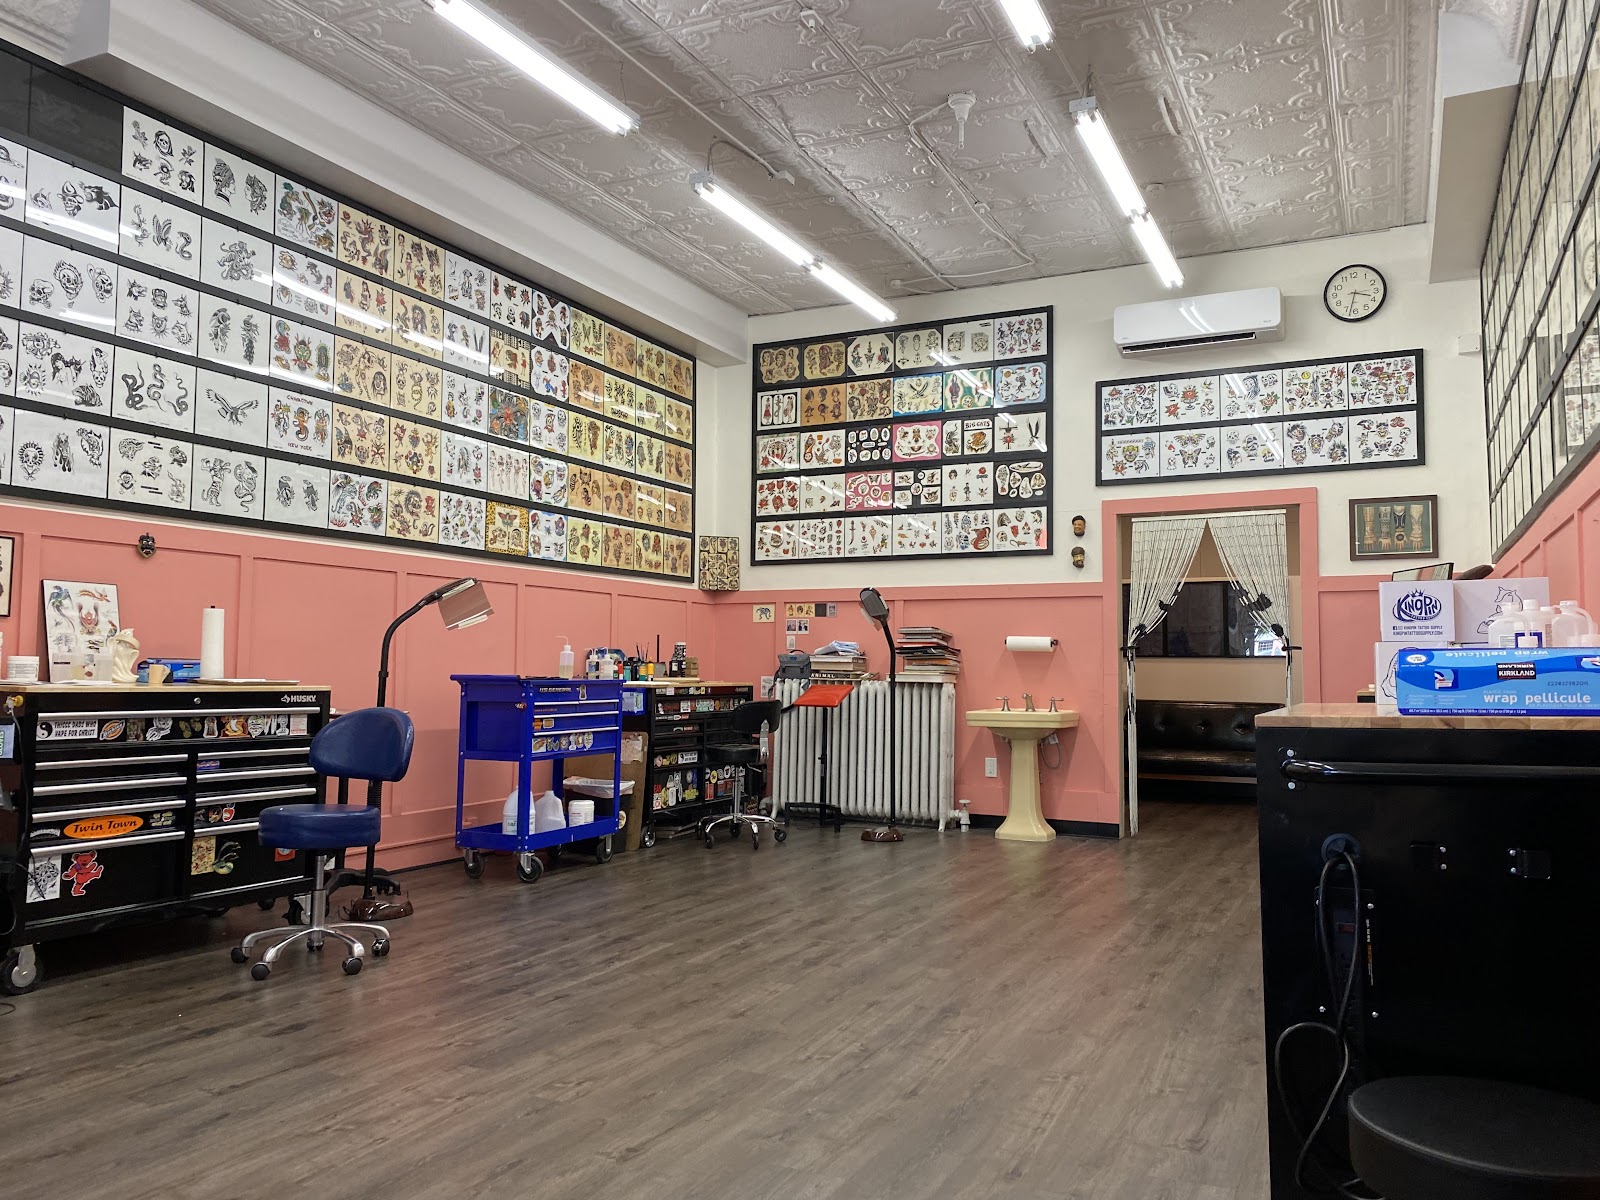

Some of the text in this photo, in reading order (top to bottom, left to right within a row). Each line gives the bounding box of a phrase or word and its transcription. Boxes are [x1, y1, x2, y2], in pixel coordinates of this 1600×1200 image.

[1484, 692, 1591, 705] wrap pellicule
[73, 823, 103, 834] Twin
[108, 820, 138, 830] Town
